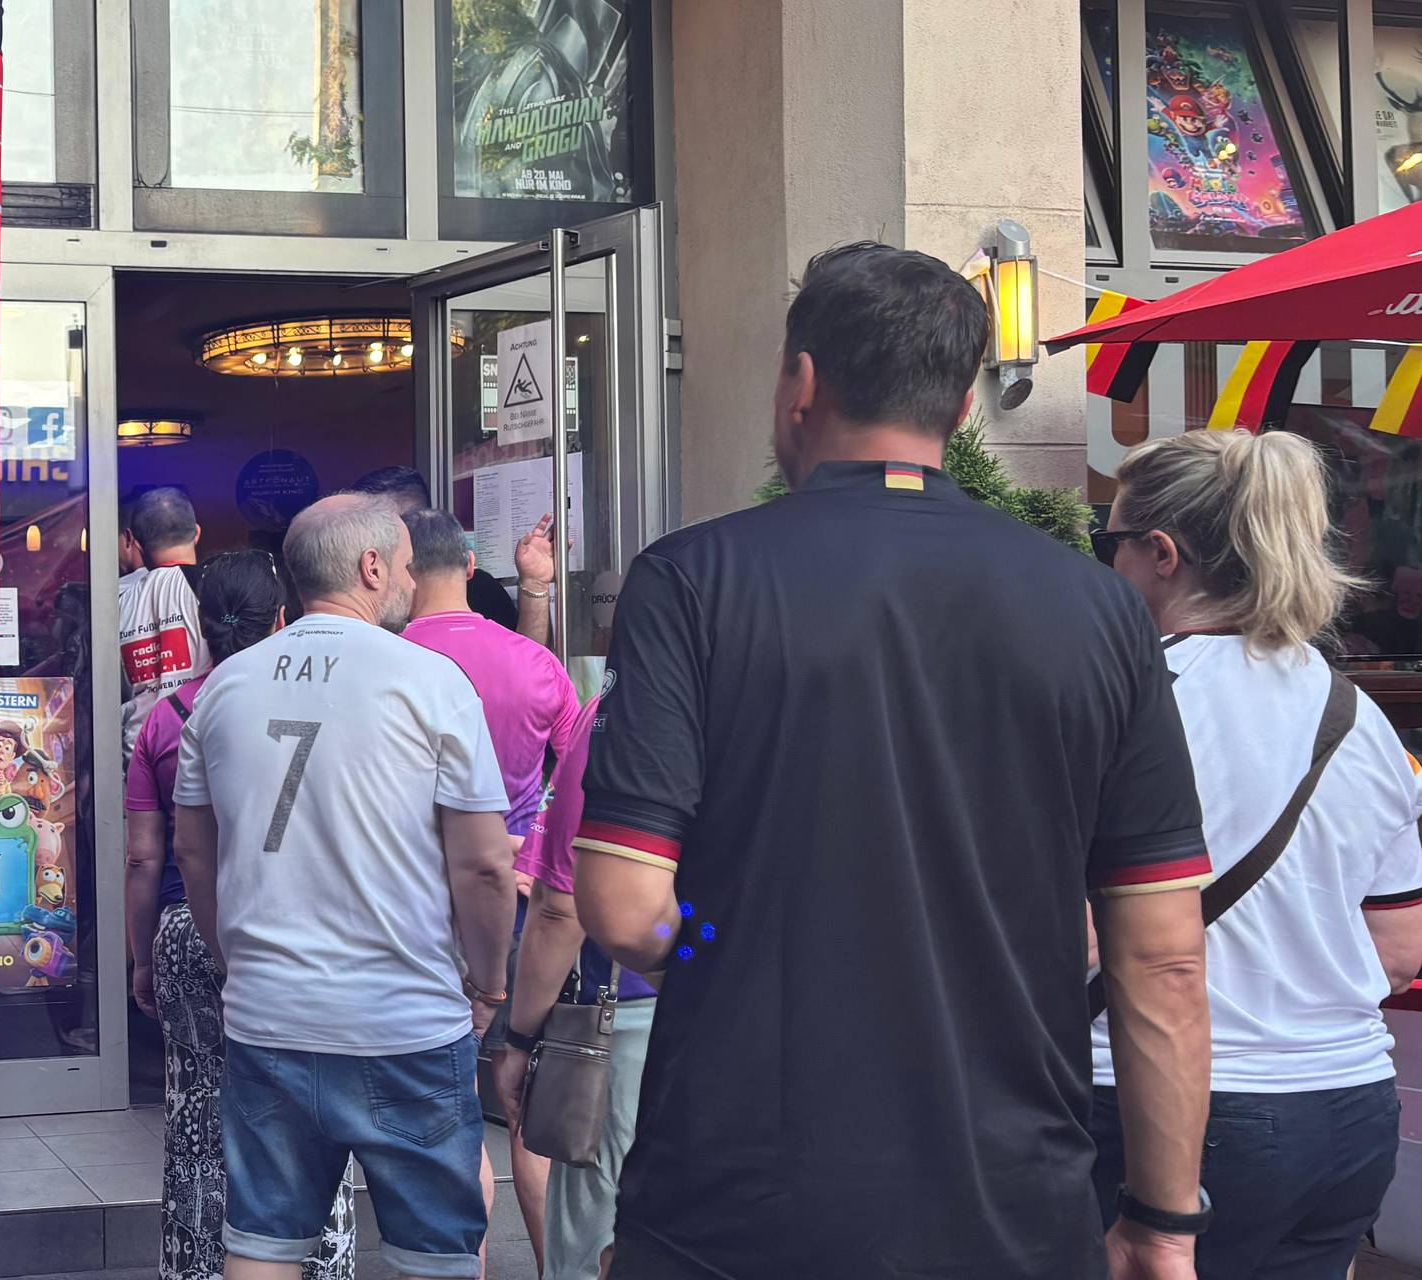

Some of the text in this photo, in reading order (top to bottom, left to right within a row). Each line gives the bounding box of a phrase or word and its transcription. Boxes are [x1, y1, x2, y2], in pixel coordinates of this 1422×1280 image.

[498, 107, 515, 116] THE
[476, 96, 605, 146] MANDALORIAN
[504, 125, 585, 164] AND GROGU
[548, 170, 565, 181] MAI
[515, 178, 535, 190] NUR
[509, 339, 539, 352] ACHTUNG
[590, 593, 619, 605] DRÜCK
[272, 654, 340, 683] RAY
[262, 718, 323, 854] 7
